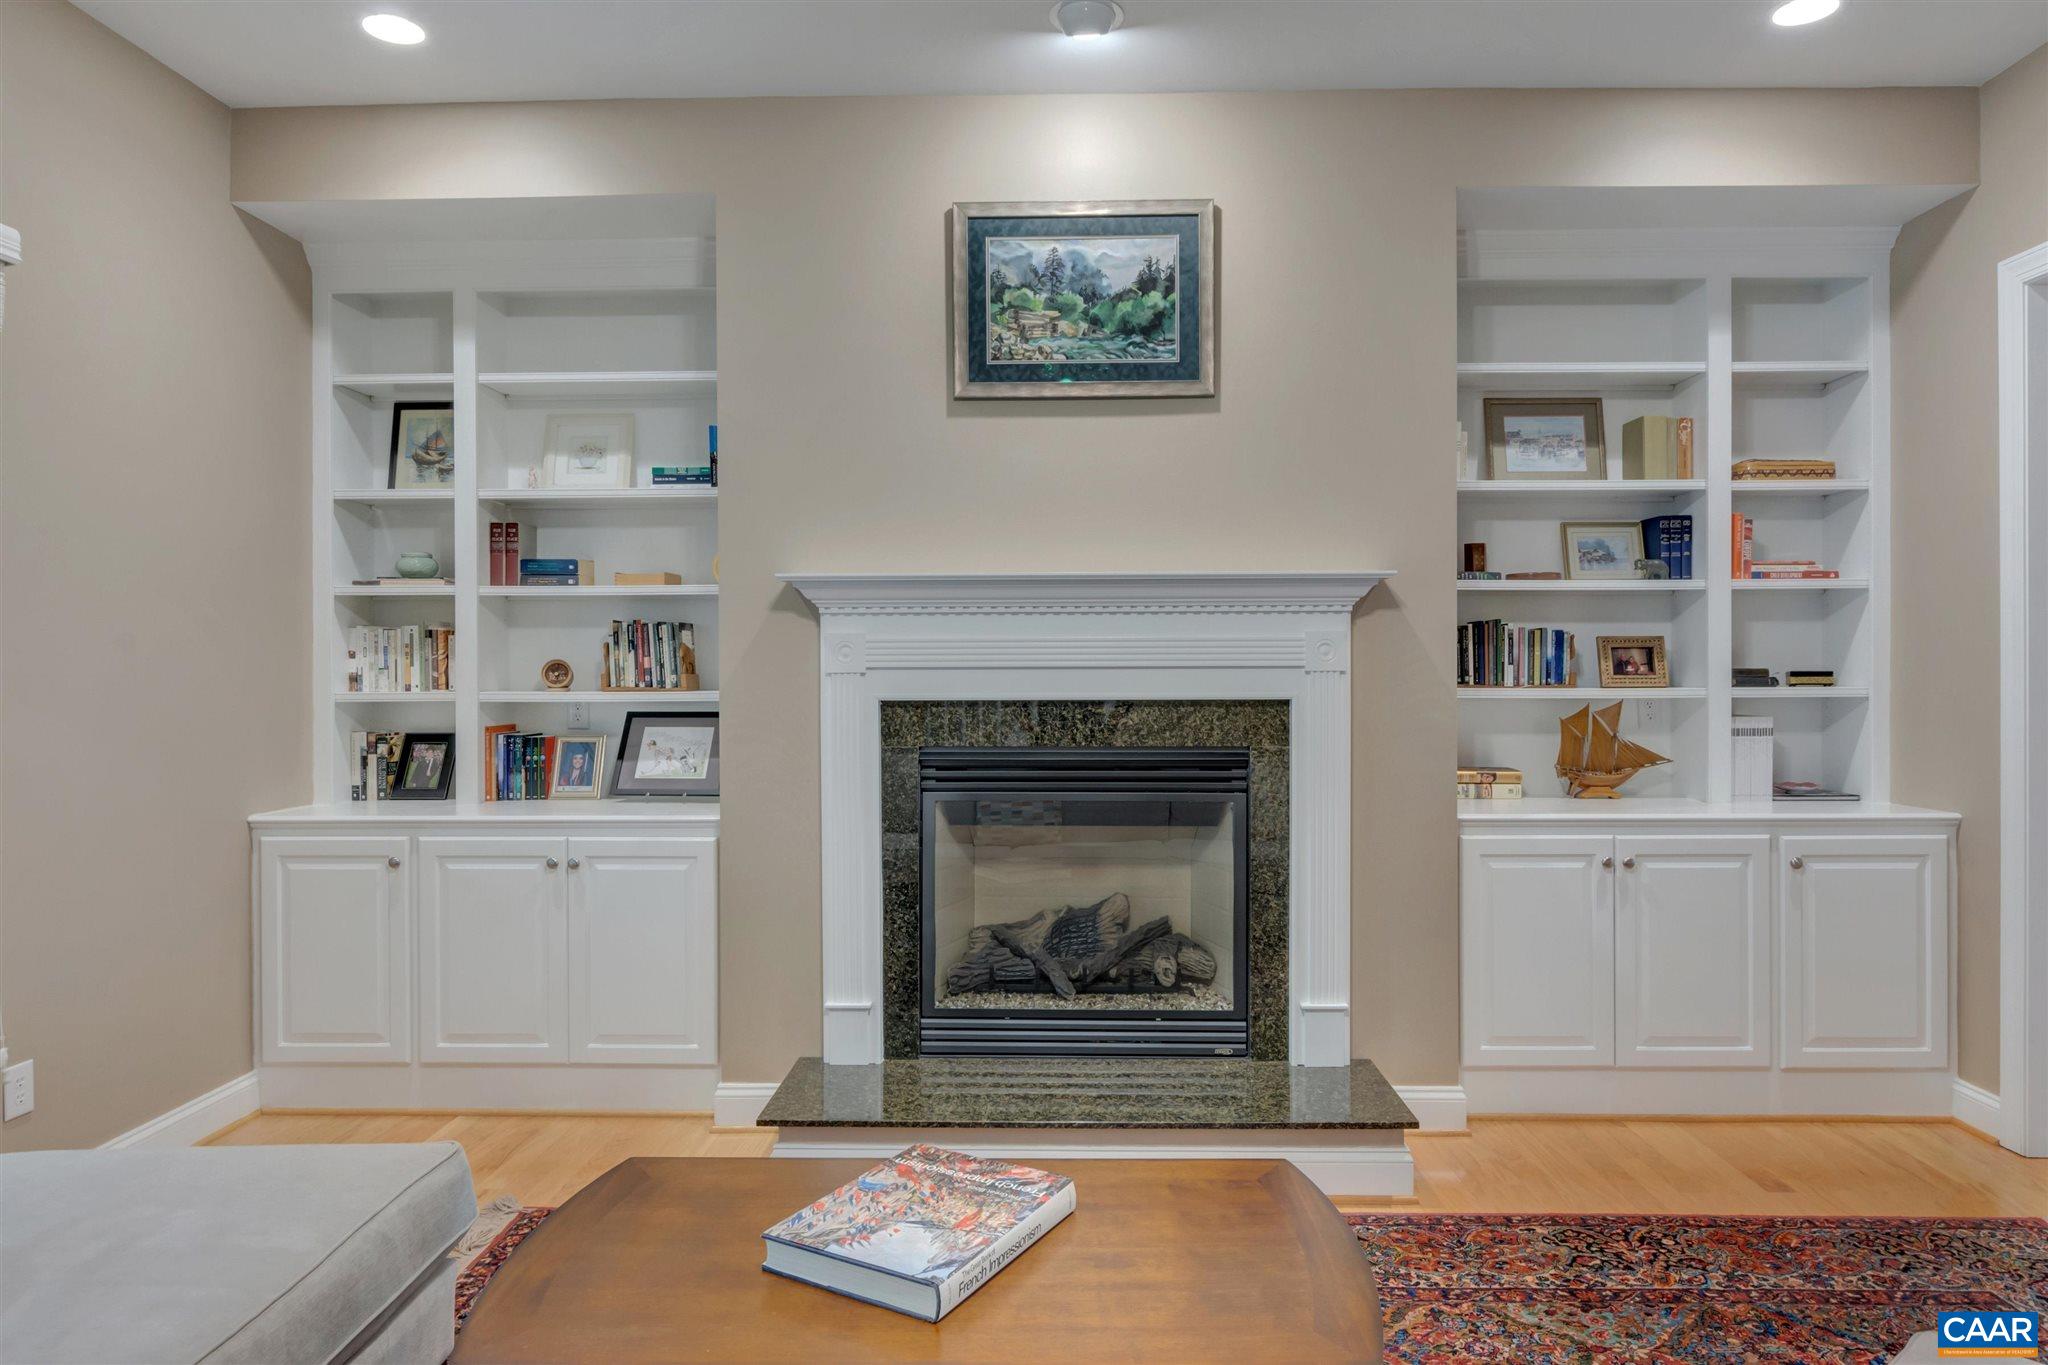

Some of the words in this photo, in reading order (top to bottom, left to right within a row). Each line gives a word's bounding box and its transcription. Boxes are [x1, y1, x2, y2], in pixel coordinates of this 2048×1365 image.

[894, 1157, 995, 1186] Impressionism
[995, 1180, 1047, 1198] French
[958, 1266, 987, 1298] French
[988, 1223, 1042, 1273] Impressionism
